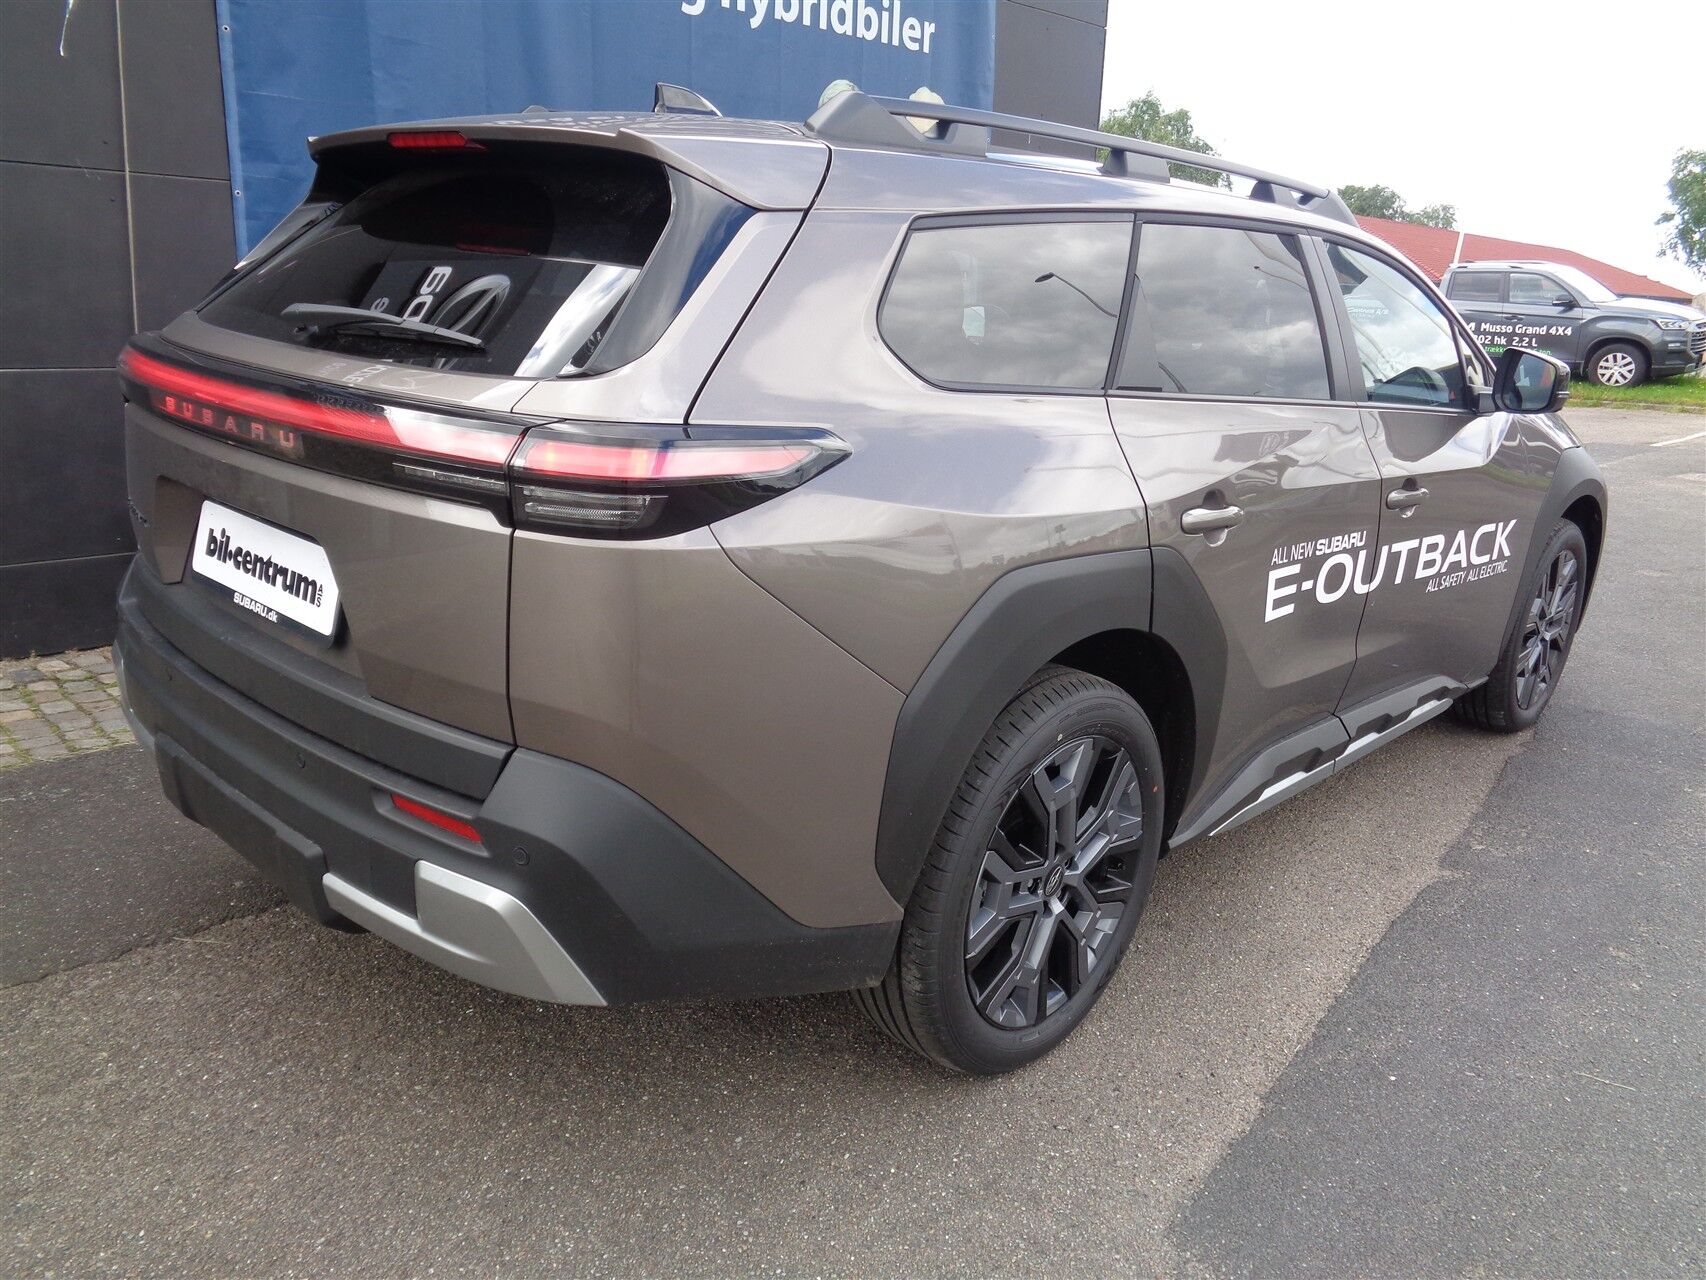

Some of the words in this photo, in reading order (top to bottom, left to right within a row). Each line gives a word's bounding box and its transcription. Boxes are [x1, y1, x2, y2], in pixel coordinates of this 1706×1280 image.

[720, 0, 935, 54] ybridbiler
[1480, 322, 1513, 333] Musso
[1515, 324, 1547, 335] Grand
[1493, 336, 1507, 345] hk
[1512, 337, 1529, 346] 2,2
[165, 395, 294, 448] SUBARU
[1271, 546, 1289, 566] ALL
[1290, 541, 1316, 561] NEW
[1315, 530, 1367, 556] SUBARU
[1264, 519, 1518, 623] E-OUTBACK
[1426, 578, 1439, 593] ALL
[1439, 571, 1467, 589] SAFETY
[1466, 567, 1479, 582] ALL
[233, 592, 278, 623] SUBARU.dk
